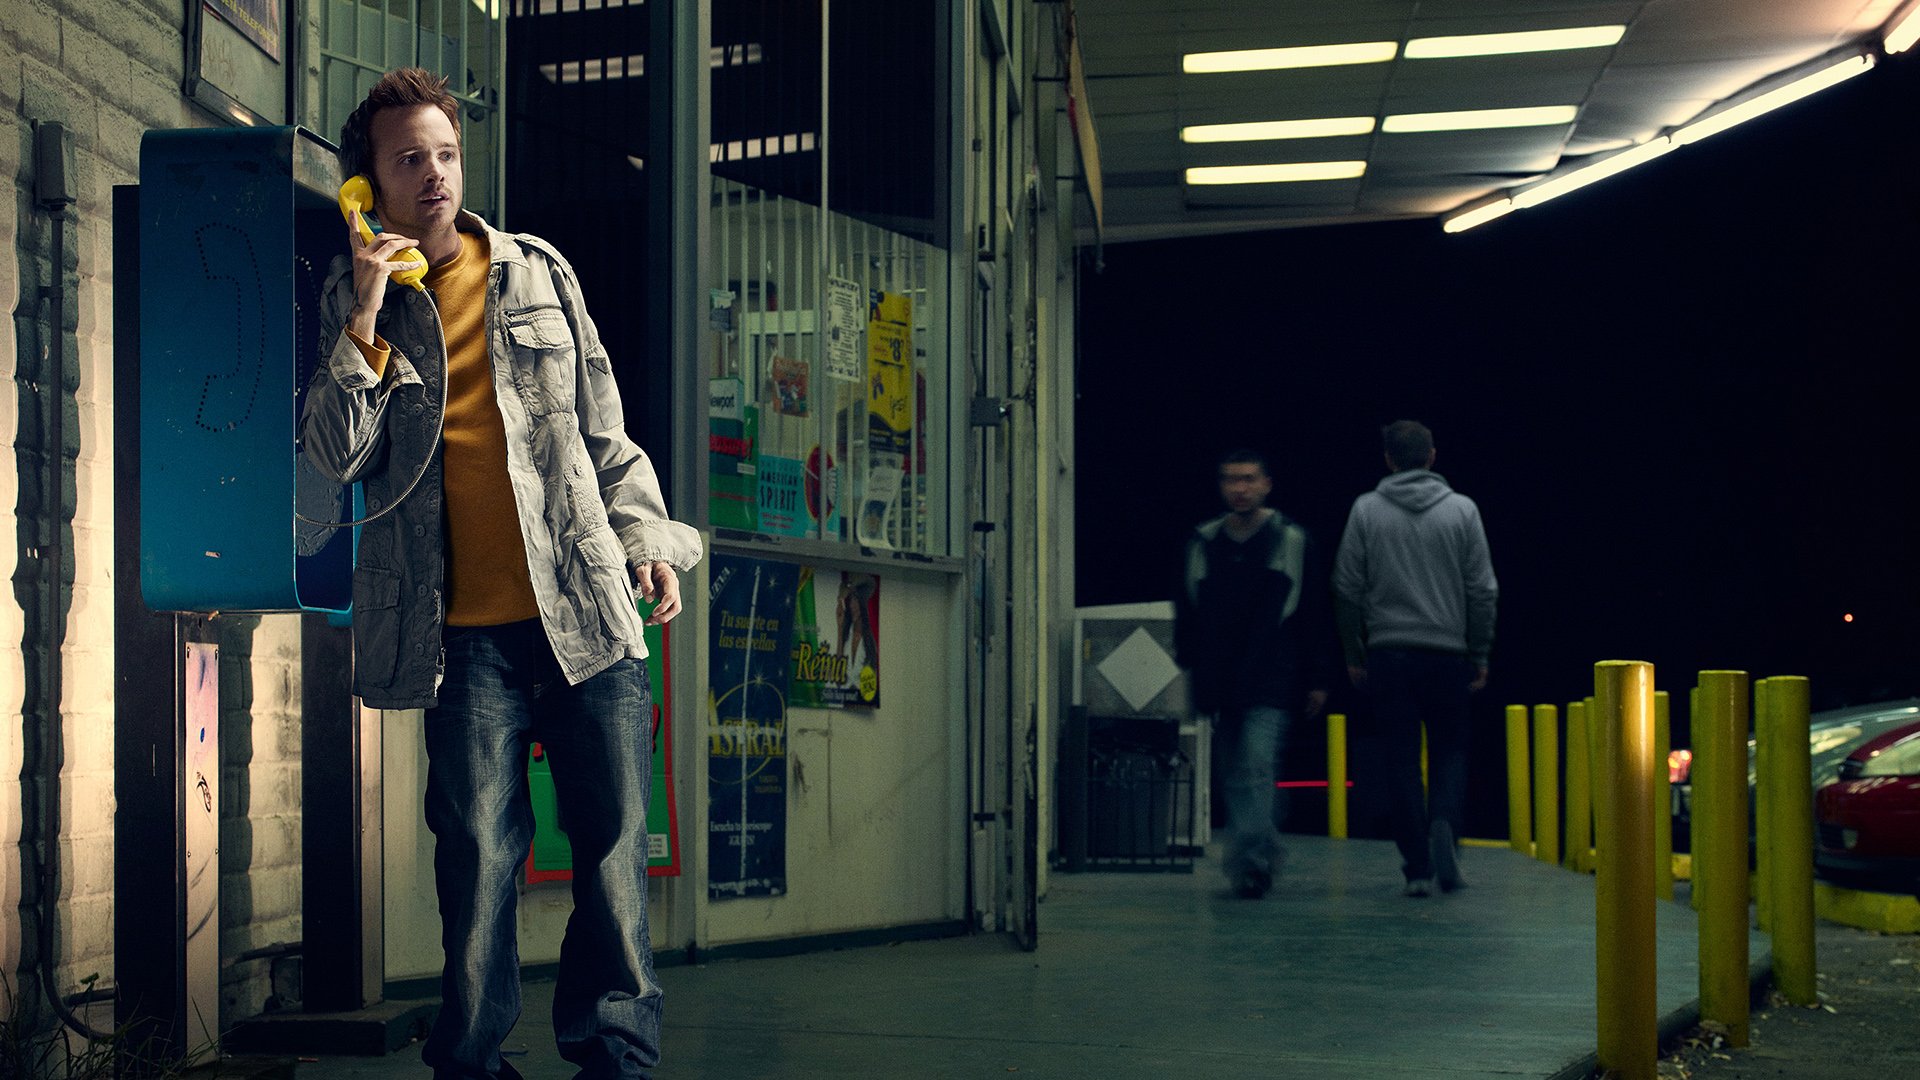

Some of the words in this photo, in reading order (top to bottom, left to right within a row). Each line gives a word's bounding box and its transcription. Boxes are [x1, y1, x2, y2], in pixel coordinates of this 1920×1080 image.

[760, 470, 798, 486] AMERICAN
[760, 485, 797, 511] SPIRIT
[720, 609, 734, 628] Tu
[766, 618, 779, 632] en
[796, 641, 849, 684] Reina
[708, 687, 784, 756] ASTRAL
